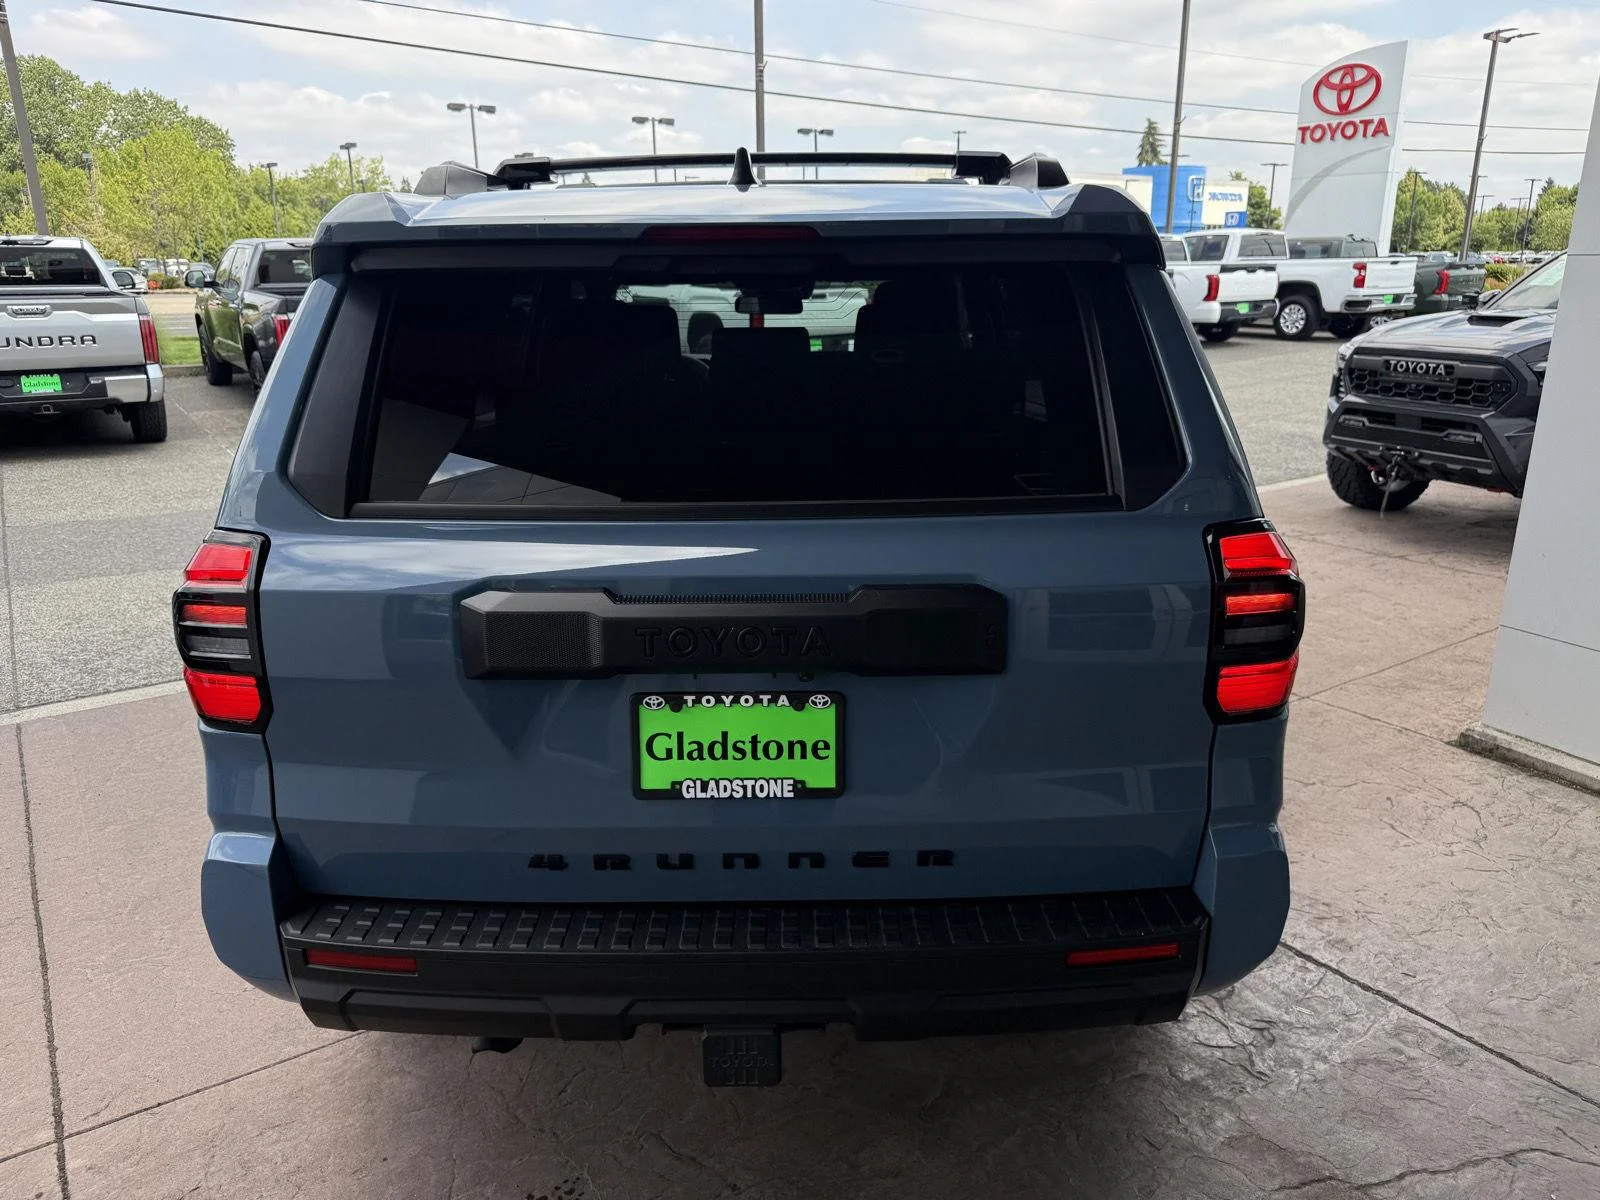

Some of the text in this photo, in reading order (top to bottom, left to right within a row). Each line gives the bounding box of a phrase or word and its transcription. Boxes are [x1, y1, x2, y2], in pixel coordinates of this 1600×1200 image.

[1298, 117, 1389, 144] TOYOTA
[1389, 360, 1445, 376] TOYOTA
[635, 626, 832, 658] TOYOTA
[684, 695, 790, 707] TOYOTA
[645, 731, 831, 761] Gladstone
[682, 779, 794, 798] GLADSTONE
[528, 850, 955, 871] 4RUNNER
